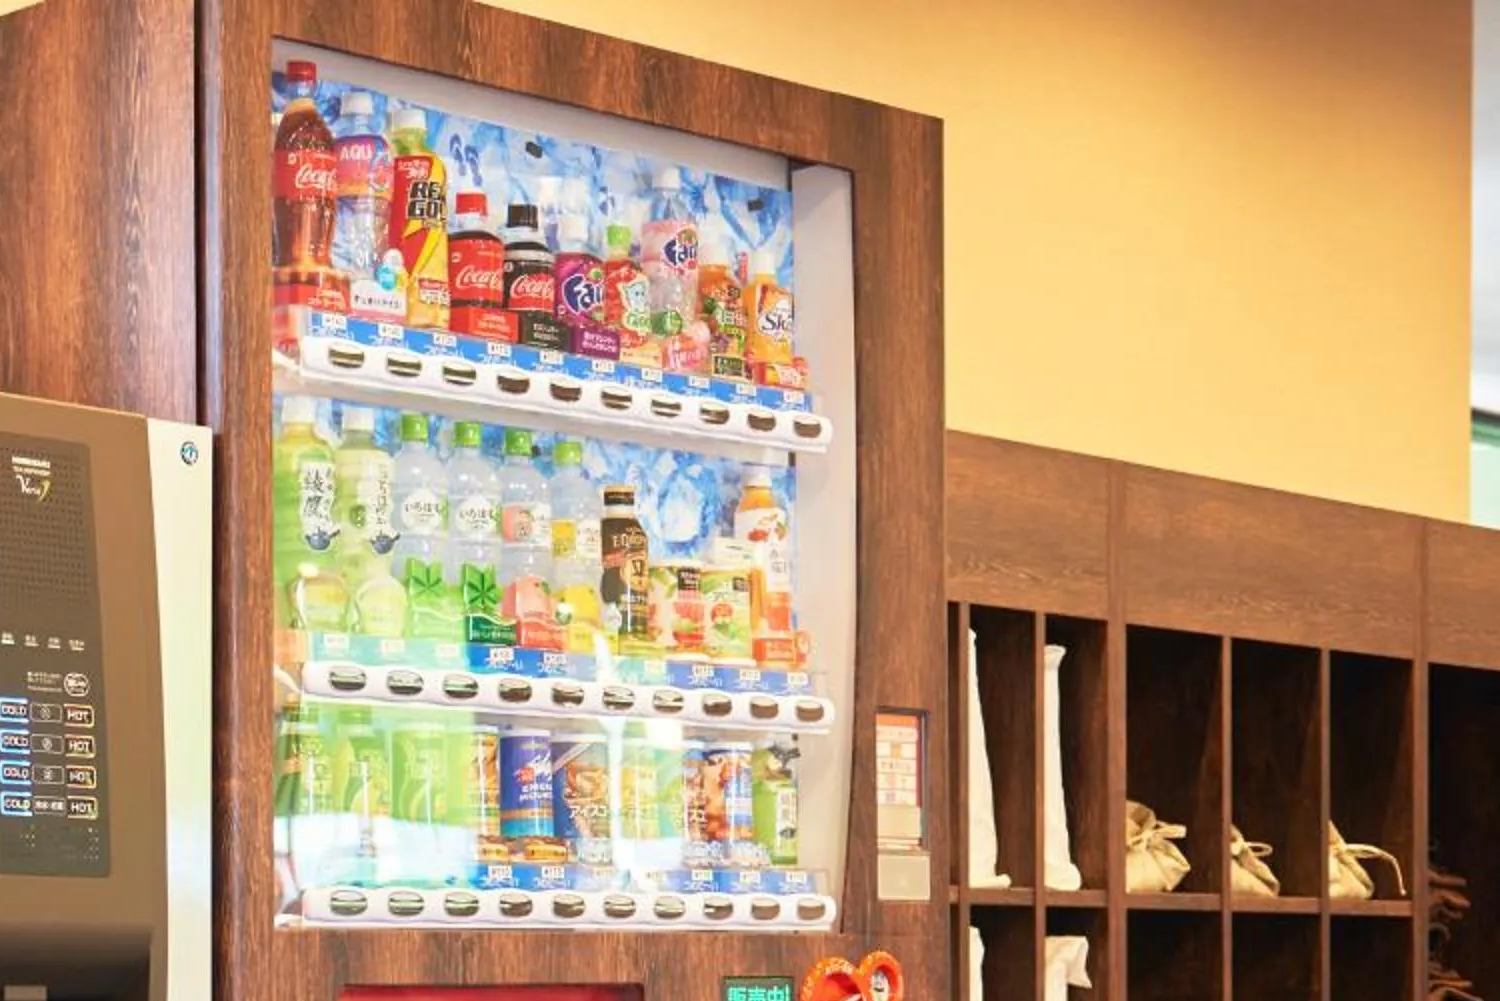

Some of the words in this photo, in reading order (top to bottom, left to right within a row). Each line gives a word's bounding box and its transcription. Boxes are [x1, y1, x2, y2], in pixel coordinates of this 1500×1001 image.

[67, 709, 89, 722] HOT
[68, 739, 90, 752] HOT
[69, 771, 92, 784] HOT
[70, 801, 93, 813] HOT
